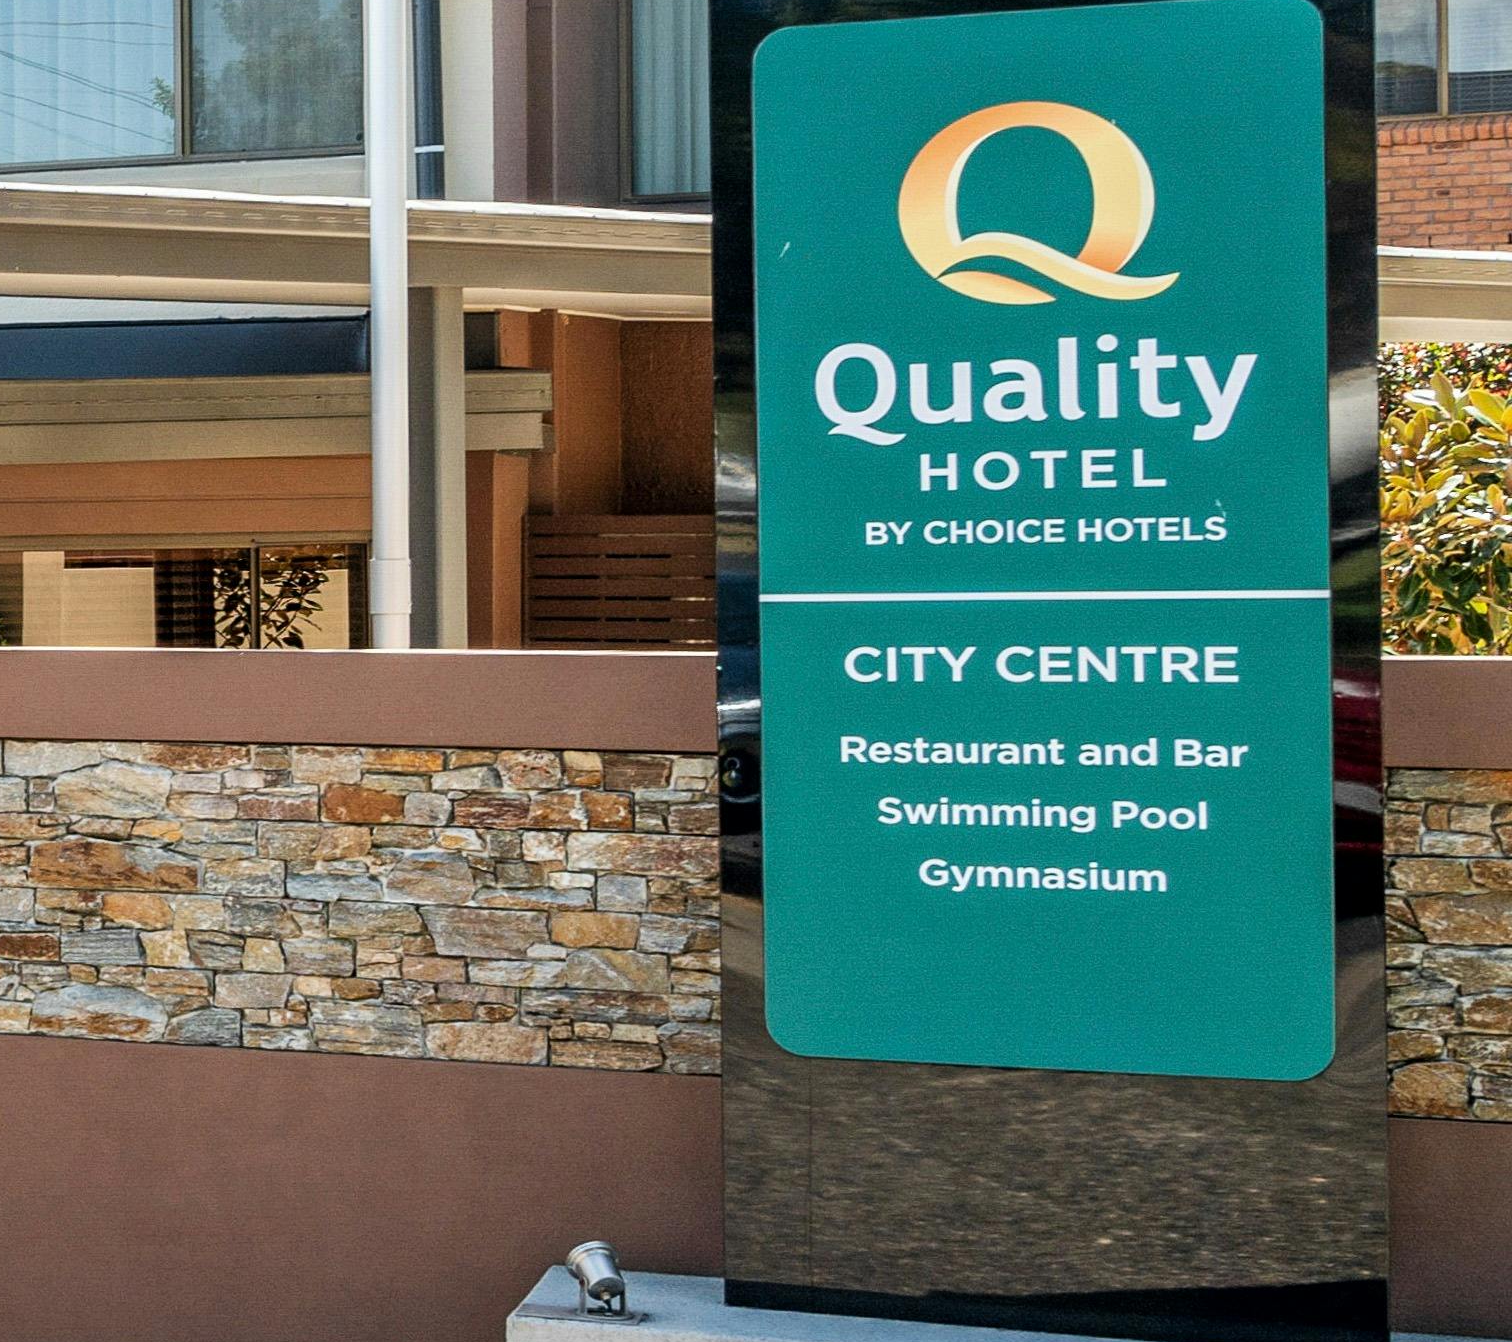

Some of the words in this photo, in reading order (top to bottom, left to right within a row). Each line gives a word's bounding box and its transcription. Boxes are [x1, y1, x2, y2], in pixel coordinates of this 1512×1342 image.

[814, 334, 1258, 447] Quality
[920, 448, 1167, 491] HOTEL
[865, 521, 912, 545] BY
[923, 519, 1066, 545] CHOICE
[1078, 516, 1227, 543] HOTELS
[844, 646, 976, 683] CITY
[996, 646, 1239, 683] CENTRE
[840, 736, 1065, 765] Restaurant
[1078, 737, 1158, 766] and
[1174, 739, 1249, 767] Bar
[878, 797, 1096, 833] Swimming
[1112, 800, 1208, 830] Pool
[919, 858, 1167, 893] Gymnasium
